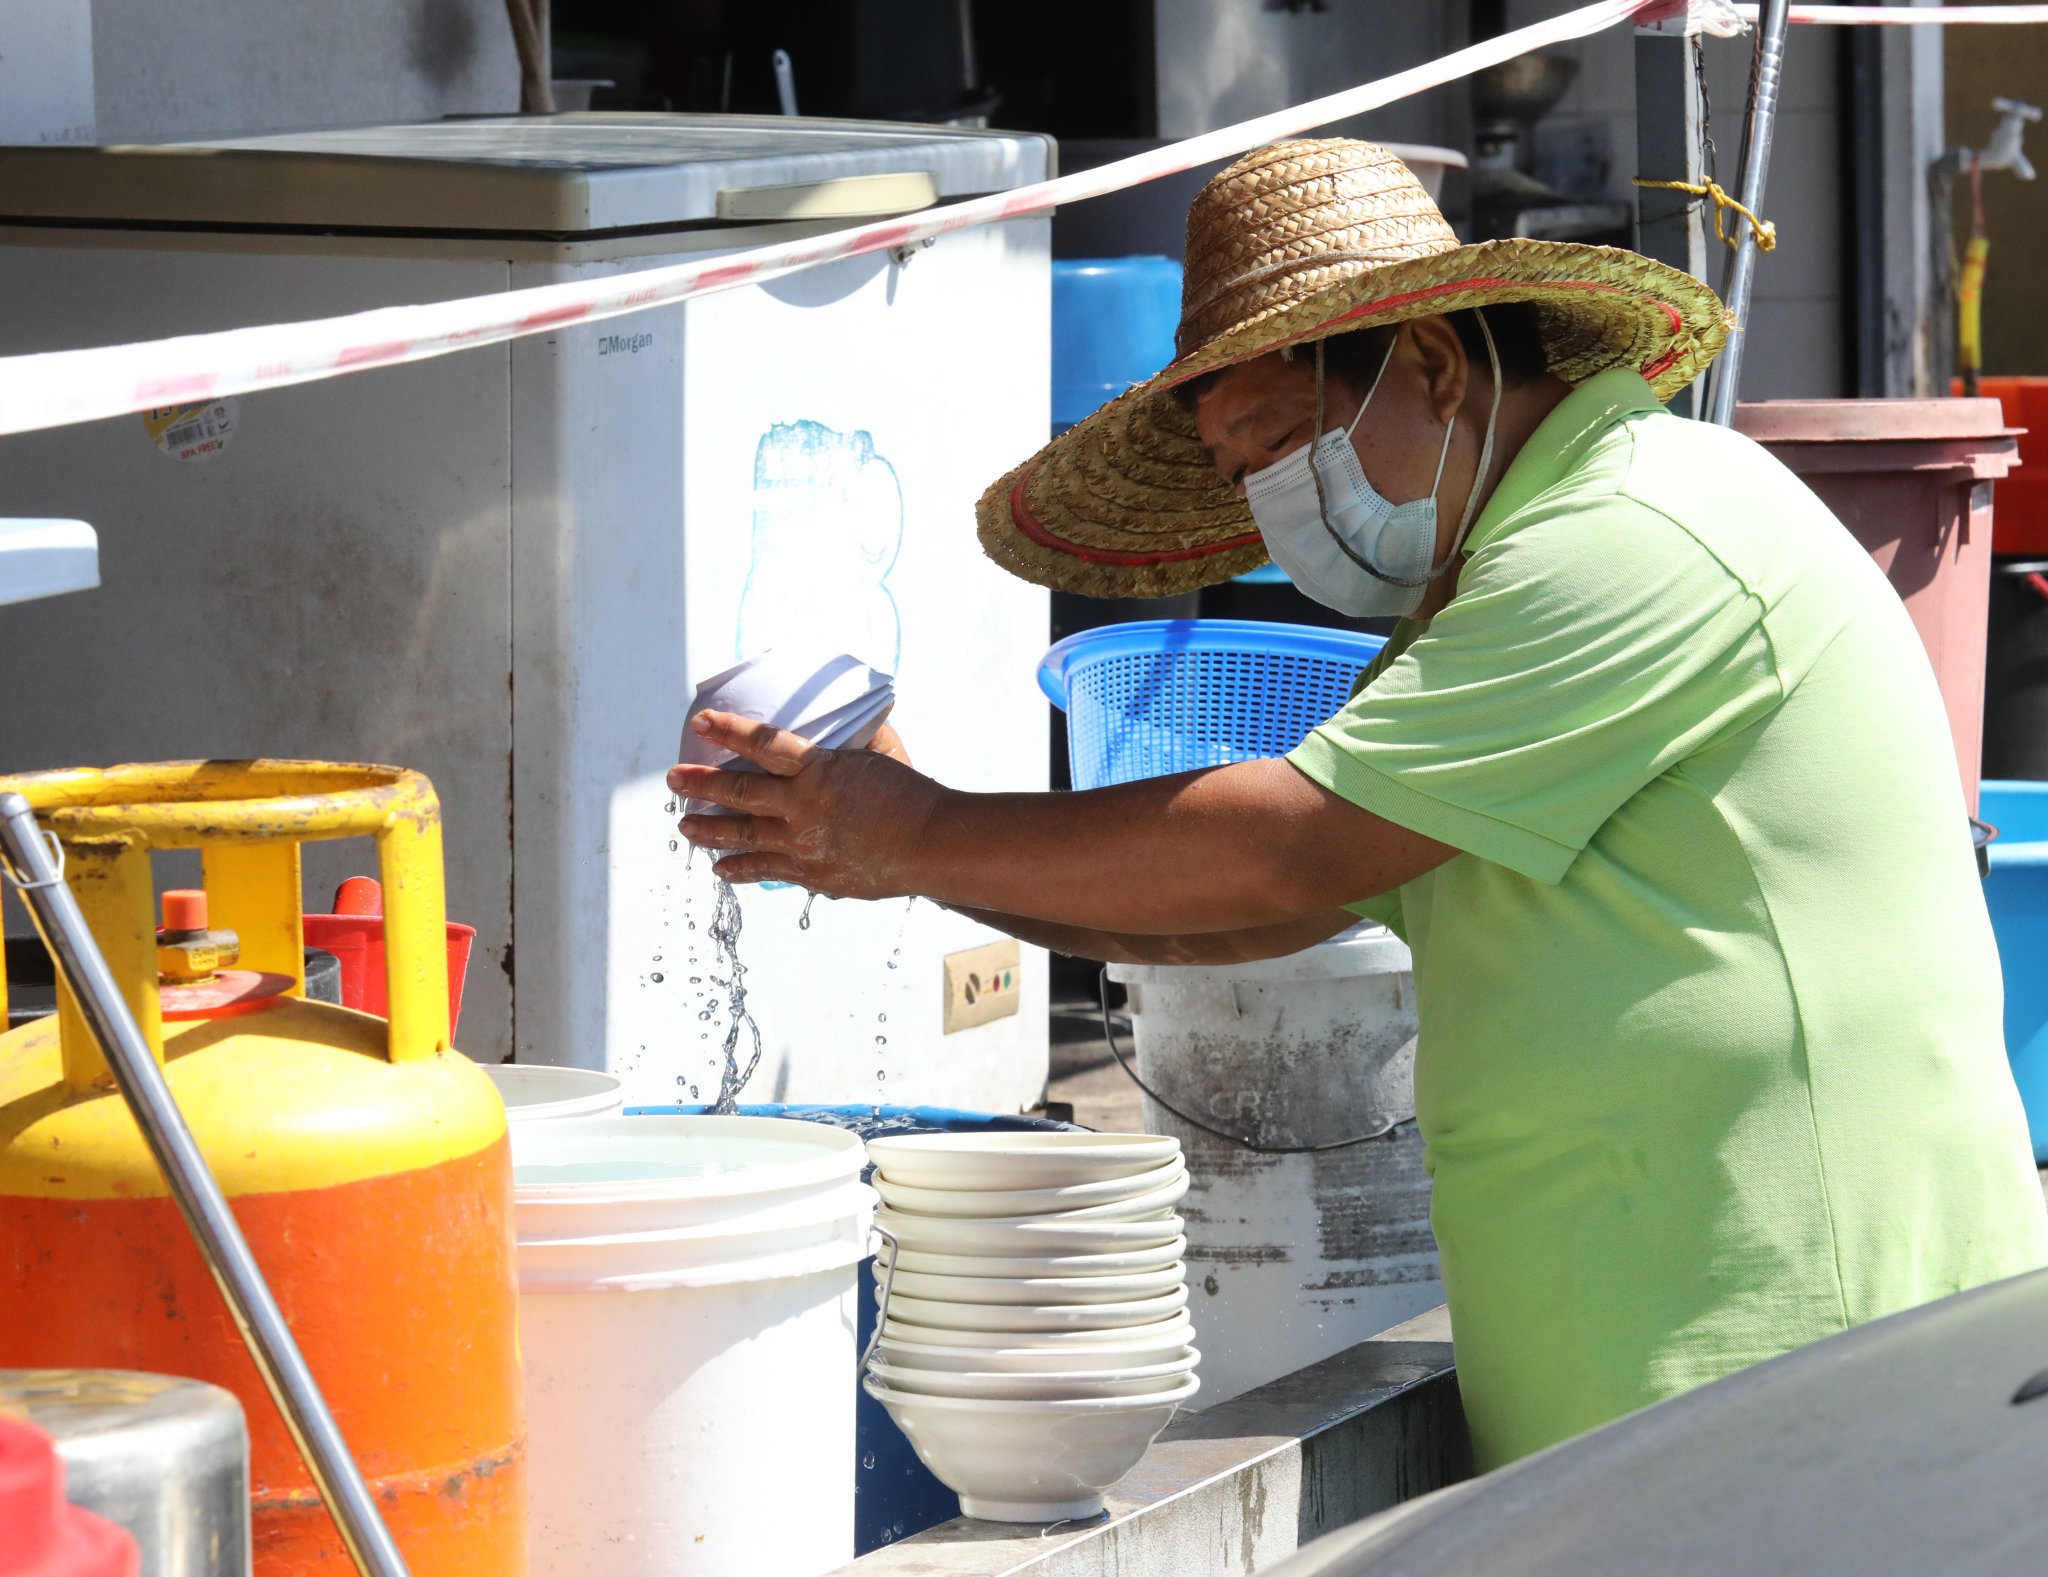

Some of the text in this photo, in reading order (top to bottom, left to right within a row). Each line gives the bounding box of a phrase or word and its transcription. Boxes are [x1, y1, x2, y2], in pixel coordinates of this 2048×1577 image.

[608, 332, 653, 354] Morgan
[180, 441, 217, 460] BPA FREE
